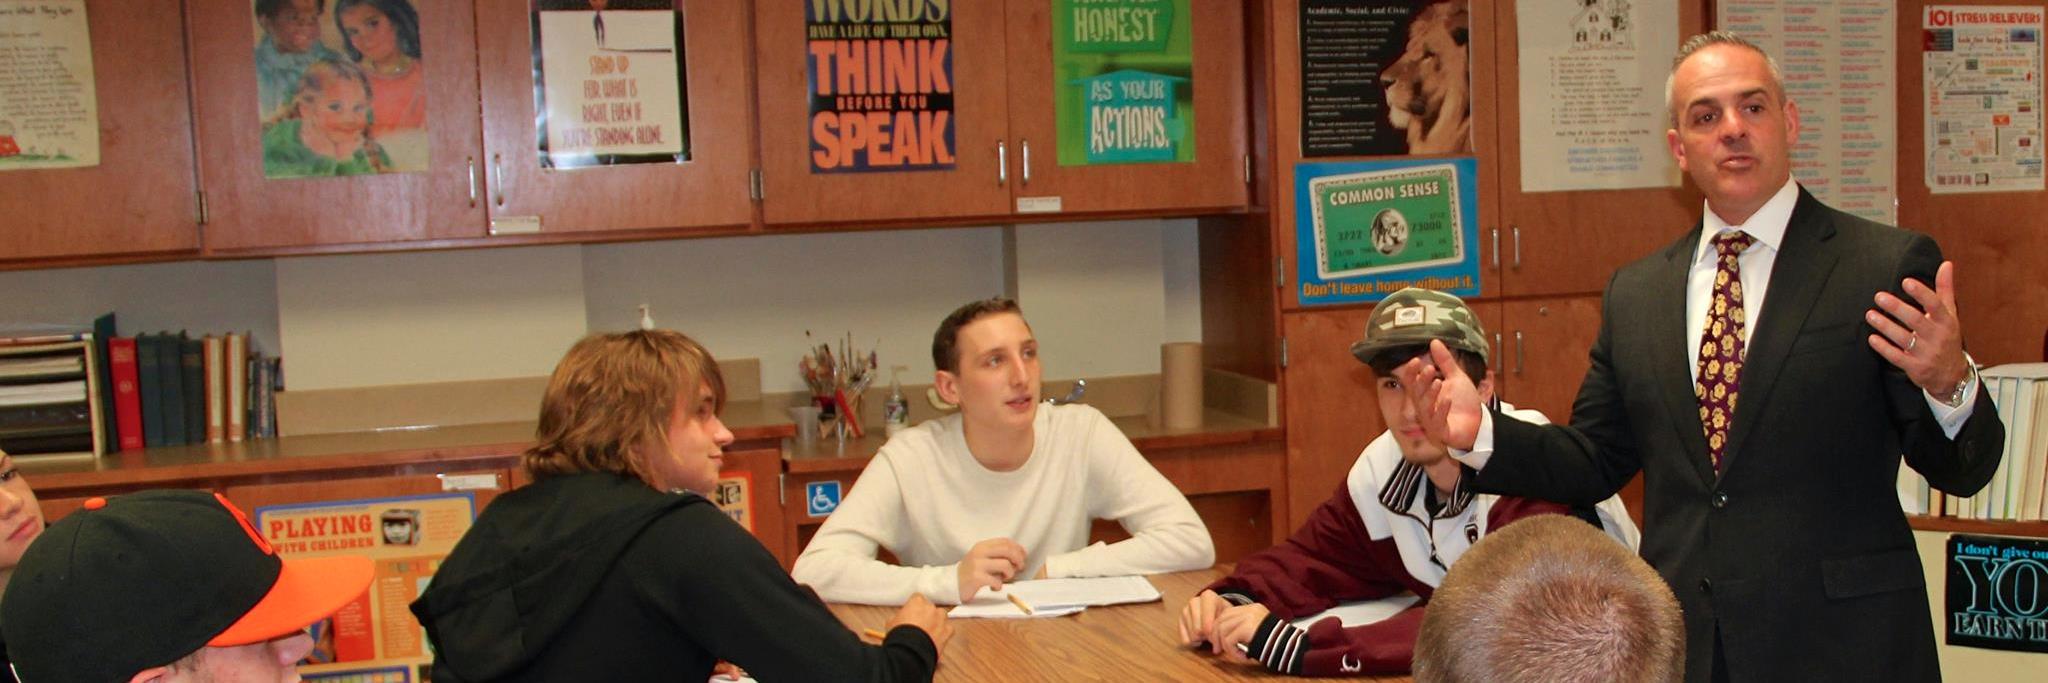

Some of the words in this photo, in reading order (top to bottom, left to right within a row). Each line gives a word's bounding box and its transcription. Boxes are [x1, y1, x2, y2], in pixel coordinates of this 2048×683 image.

[1073, 7, 1158, 43] HONEST
[1929, 9, 1953, 26] 101
[1955, 12, 1988, 24] STRESS
[1989, 11, 2041, 24] RELIEVERS
[809, 39, 950, 95] THINK
[836, 96, 892, 110] BEFORE
[900, 95, 927, 110] YOU
[1091, 80, 1113, 101] AS
[1120, 80, 1165, 100] YOUR
[812, 110, 955, 168] SPEAK.
[1090, 105, 1170, 154] ACTIONS.
[1330, 187, 1394, 206] COMMON
[1400, 181, 1440, 198] SENSE
[1303, 282, 1337, 297] Don't
[1341, 279, 1374, 294] leave
[1414, 275, 1460, 290] without
[269, 513, 373, 540] PLAYING
[310, 536, 374, 551] CHILDREN
[1956, 543, 1963, 554] I
[1965, 544, 1998, 557] don't
[2002, 546, 2030, 561] give
[1954, 612, 2025, 640] EARN
